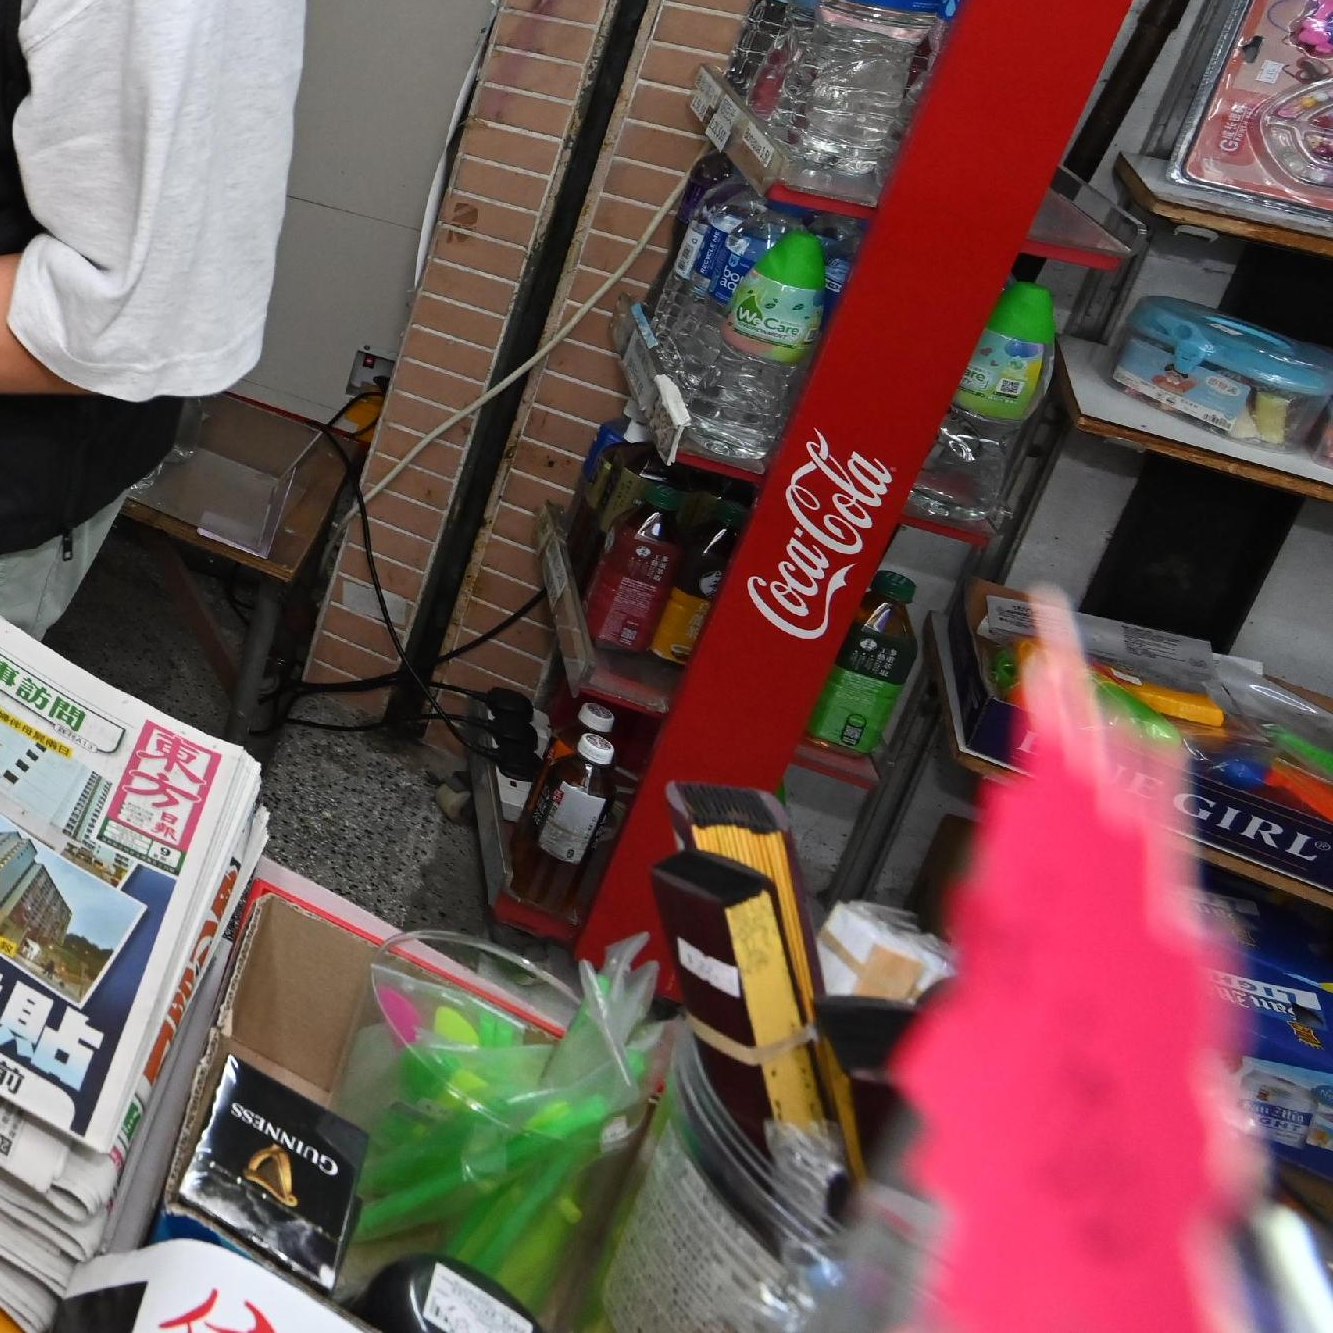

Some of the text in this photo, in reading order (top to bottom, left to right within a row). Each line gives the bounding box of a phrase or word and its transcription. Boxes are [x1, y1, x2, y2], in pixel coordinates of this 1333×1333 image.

[747, 429, 893, 639] Coca-Cola
[121, 728, 211, 844] 東方日報
[1173, 790, 1321, 862] GIRL
[230, 1100, 339, 1178] GUINNESS
